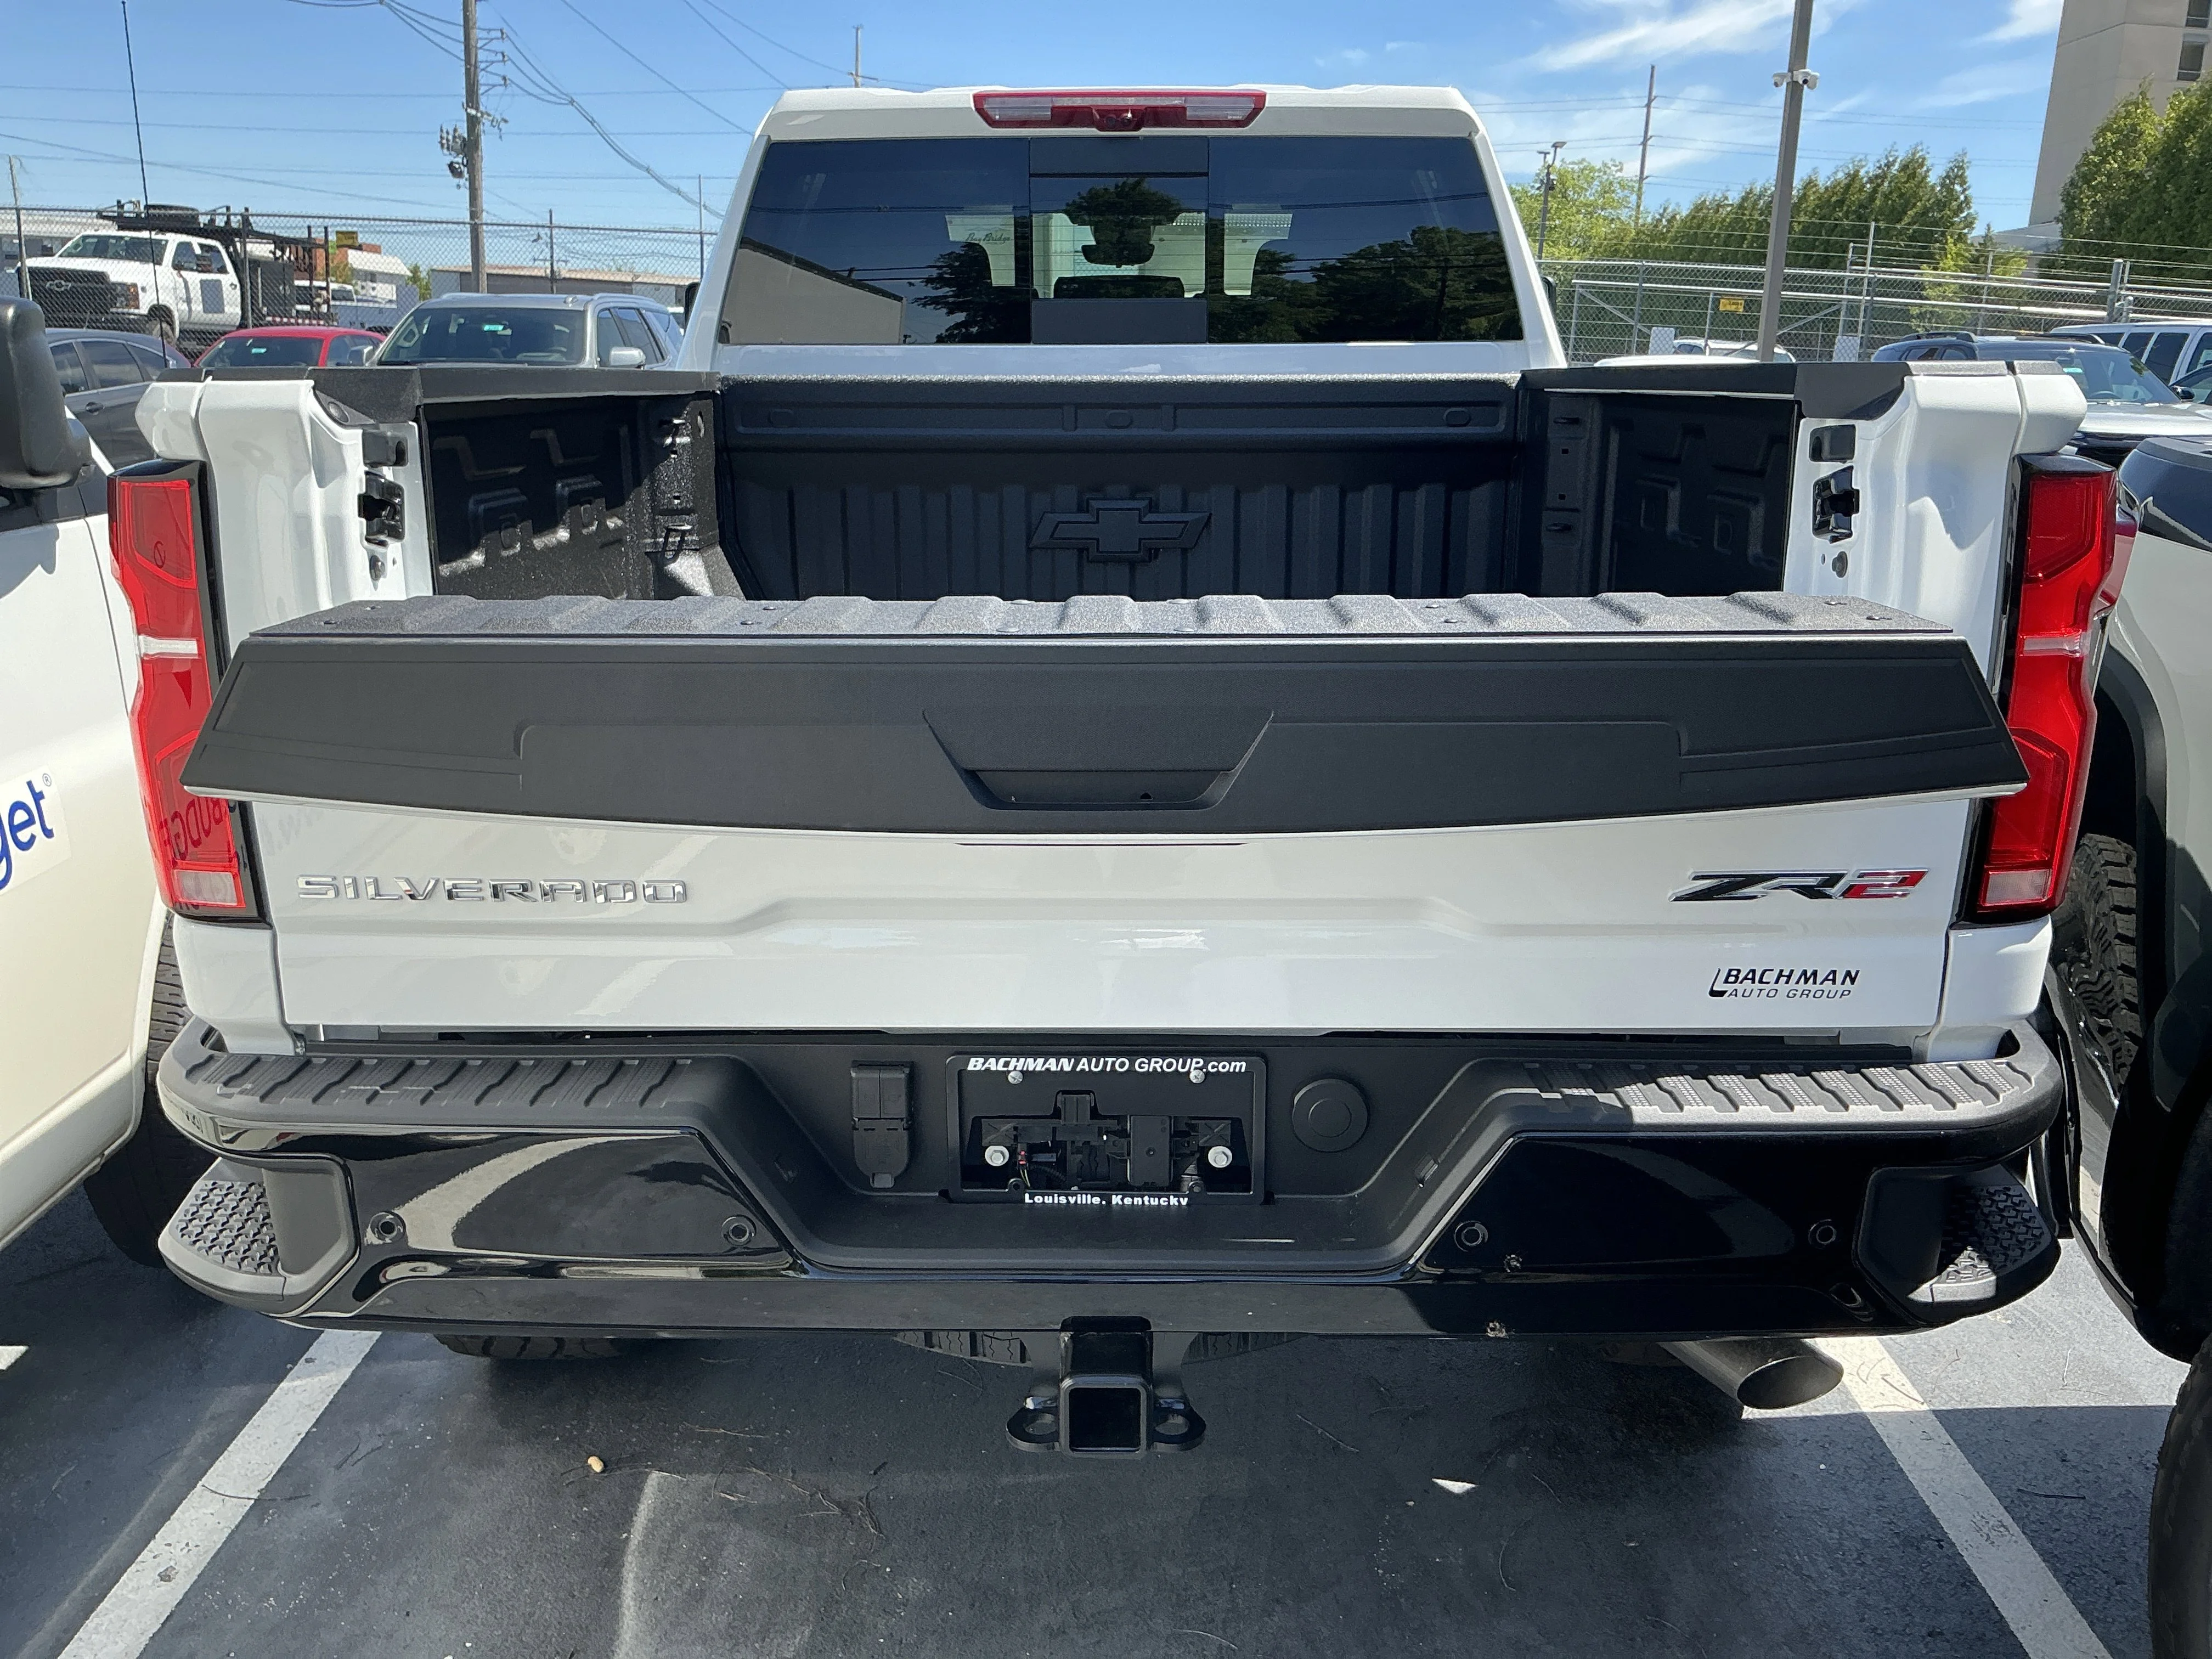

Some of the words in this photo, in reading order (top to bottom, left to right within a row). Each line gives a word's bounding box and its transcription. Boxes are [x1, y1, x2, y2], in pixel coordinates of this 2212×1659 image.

[296, 874, 687, 904] SILVERADO
[1668, 867, 1929, 901] ZR2
[1723, 968, 1860, 985] BACHMAN
[1727, 989, 1779, 998] AUTO
[1786, 989, 1852, 998] GROUP
[967, 1057, 1075, 1071] BACHMAN
[1076, 1057, 1130, 1071] AUTO
[1135, 1058, 1246, 1072] GROUP.com
[1111, 1195, 1188, 1206] Kentucky
